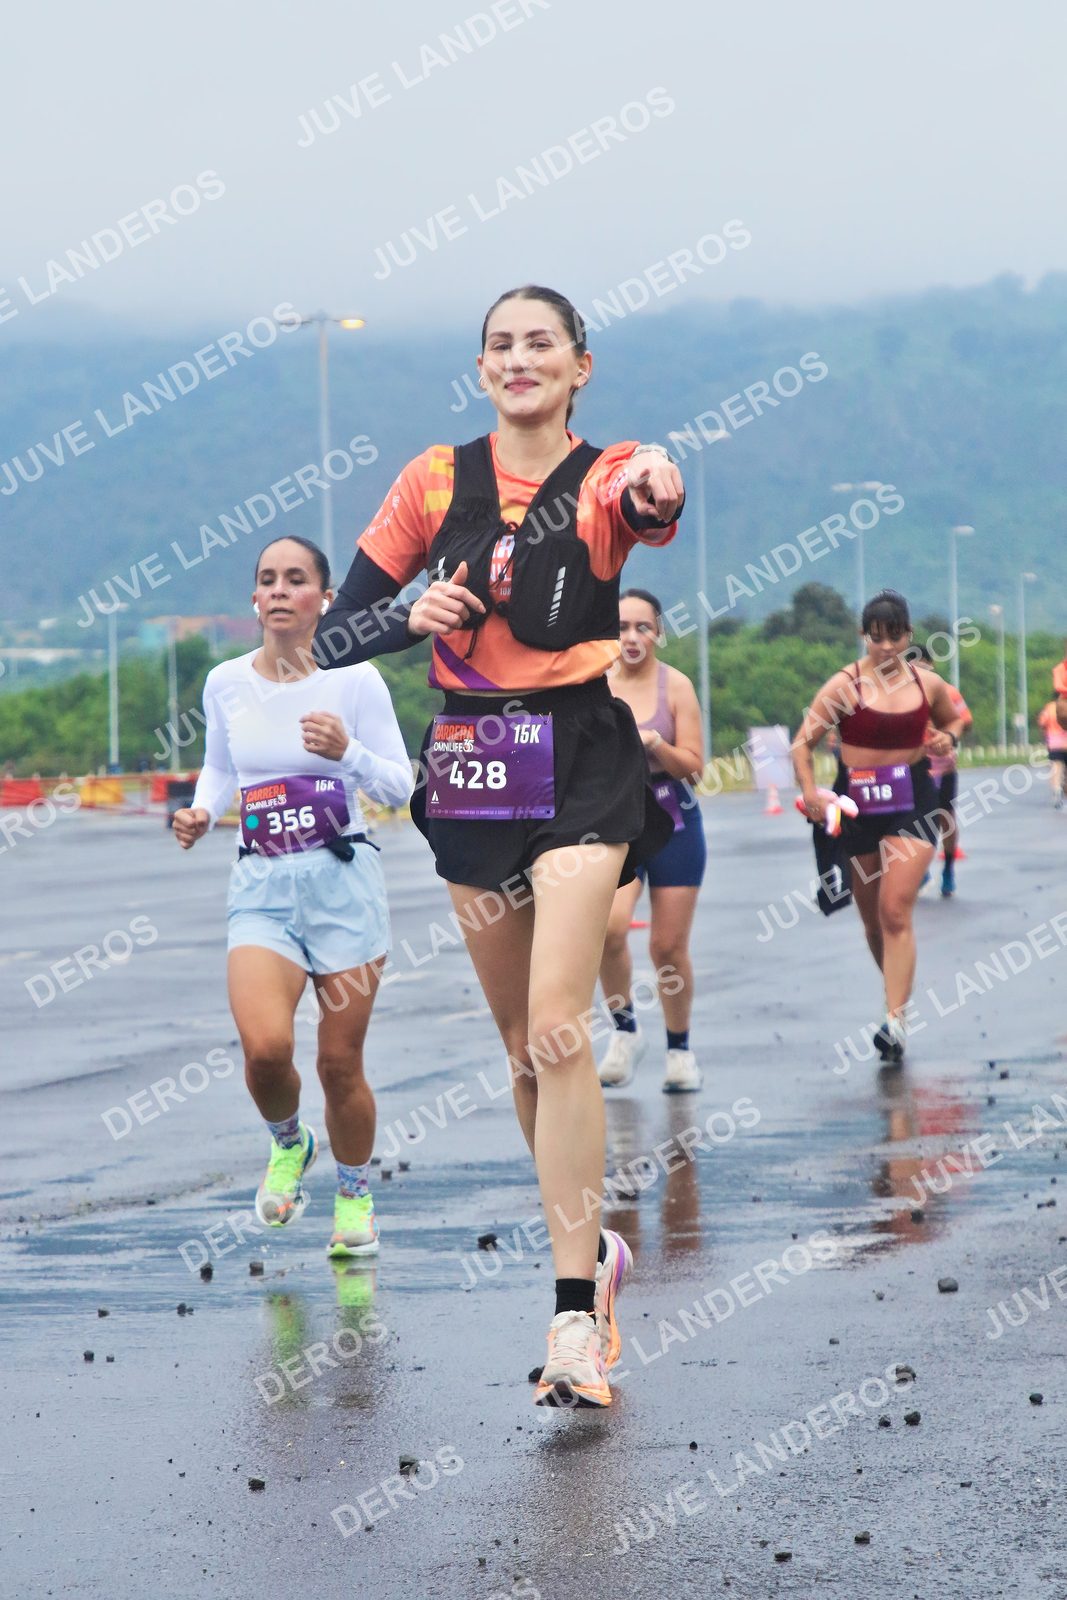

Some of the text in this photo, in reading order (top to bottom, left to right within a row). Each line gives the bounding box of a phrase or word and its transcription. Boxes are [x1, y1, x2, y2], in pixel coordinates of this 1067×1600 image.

[434, 724, 475, 741] CARRERA
[514, 724, 541, 744] 15K
[449, 760, 507, 790] 428
[246, 783, 287, 803] CARRERA
[315, 779, 336, 793] 15K
[266, 805, 317, 836] 356
